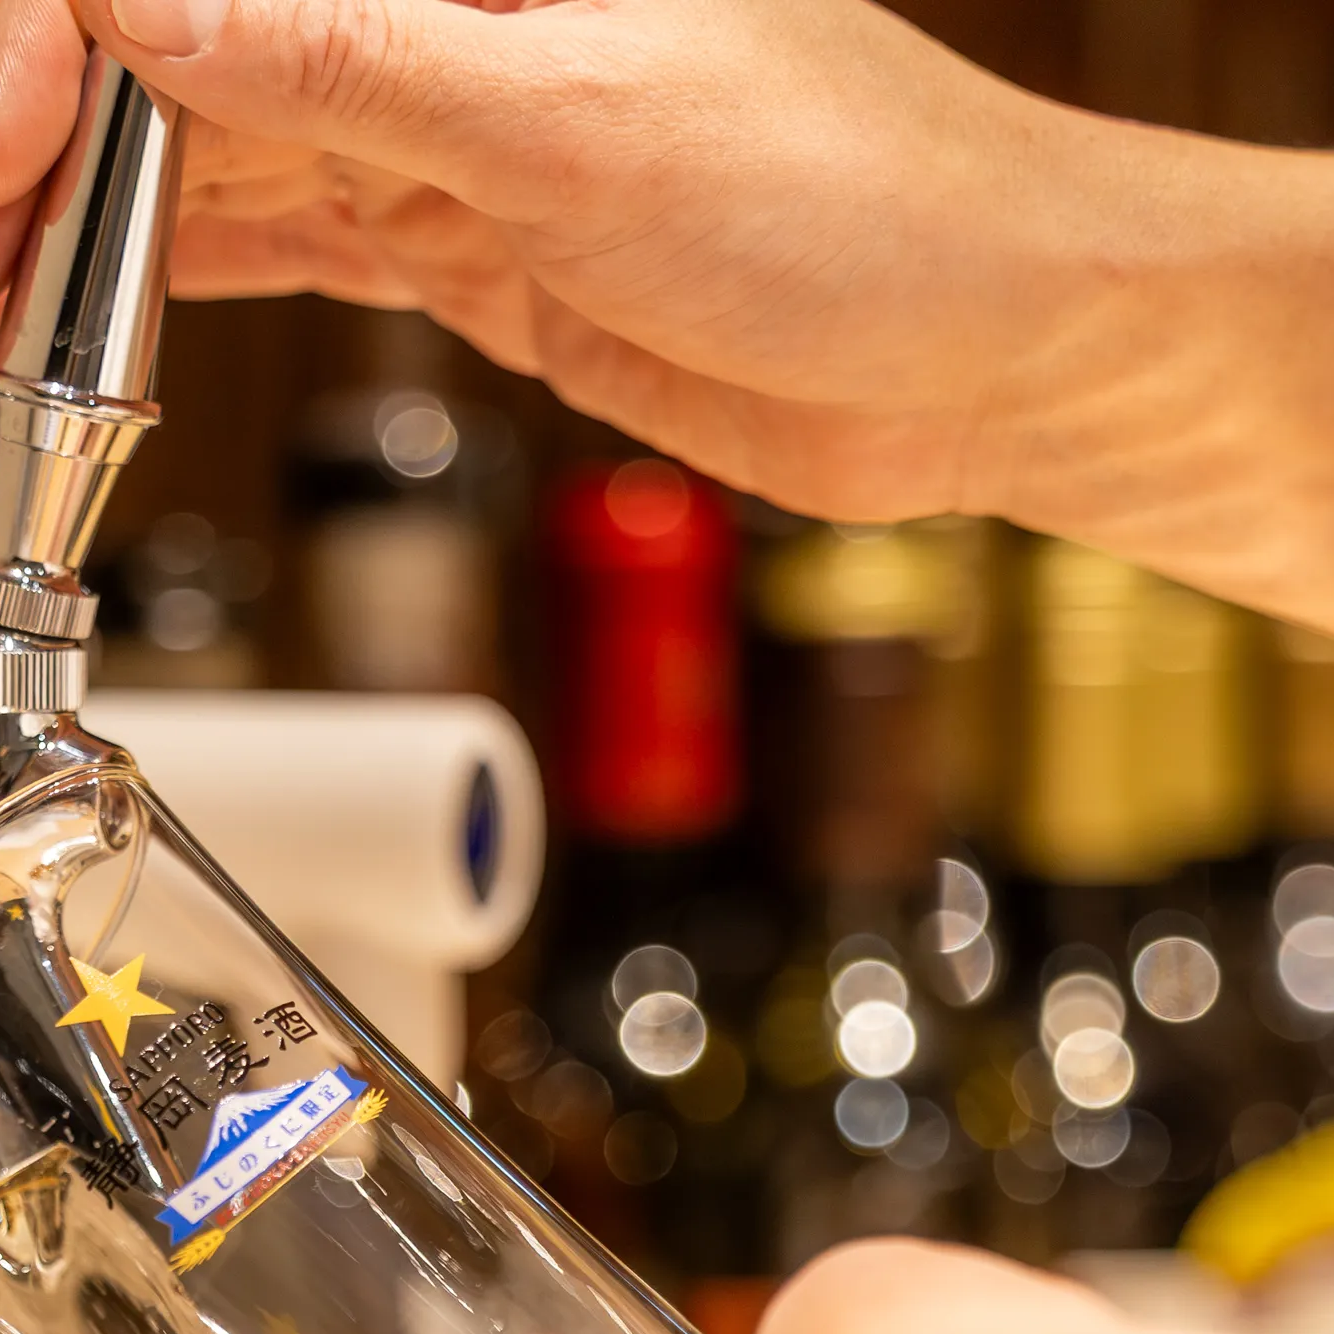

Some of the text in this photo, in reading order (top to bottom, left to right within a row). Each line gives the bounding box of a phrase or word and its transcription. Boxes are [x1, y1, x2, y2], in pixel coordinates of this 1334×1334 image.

[81, 1000, 318, 1210] 静岡麦酒
[108, 1001, 225, 1103] SAPPORO
[190, 1083, 342, 1212] ふじのくに限定
